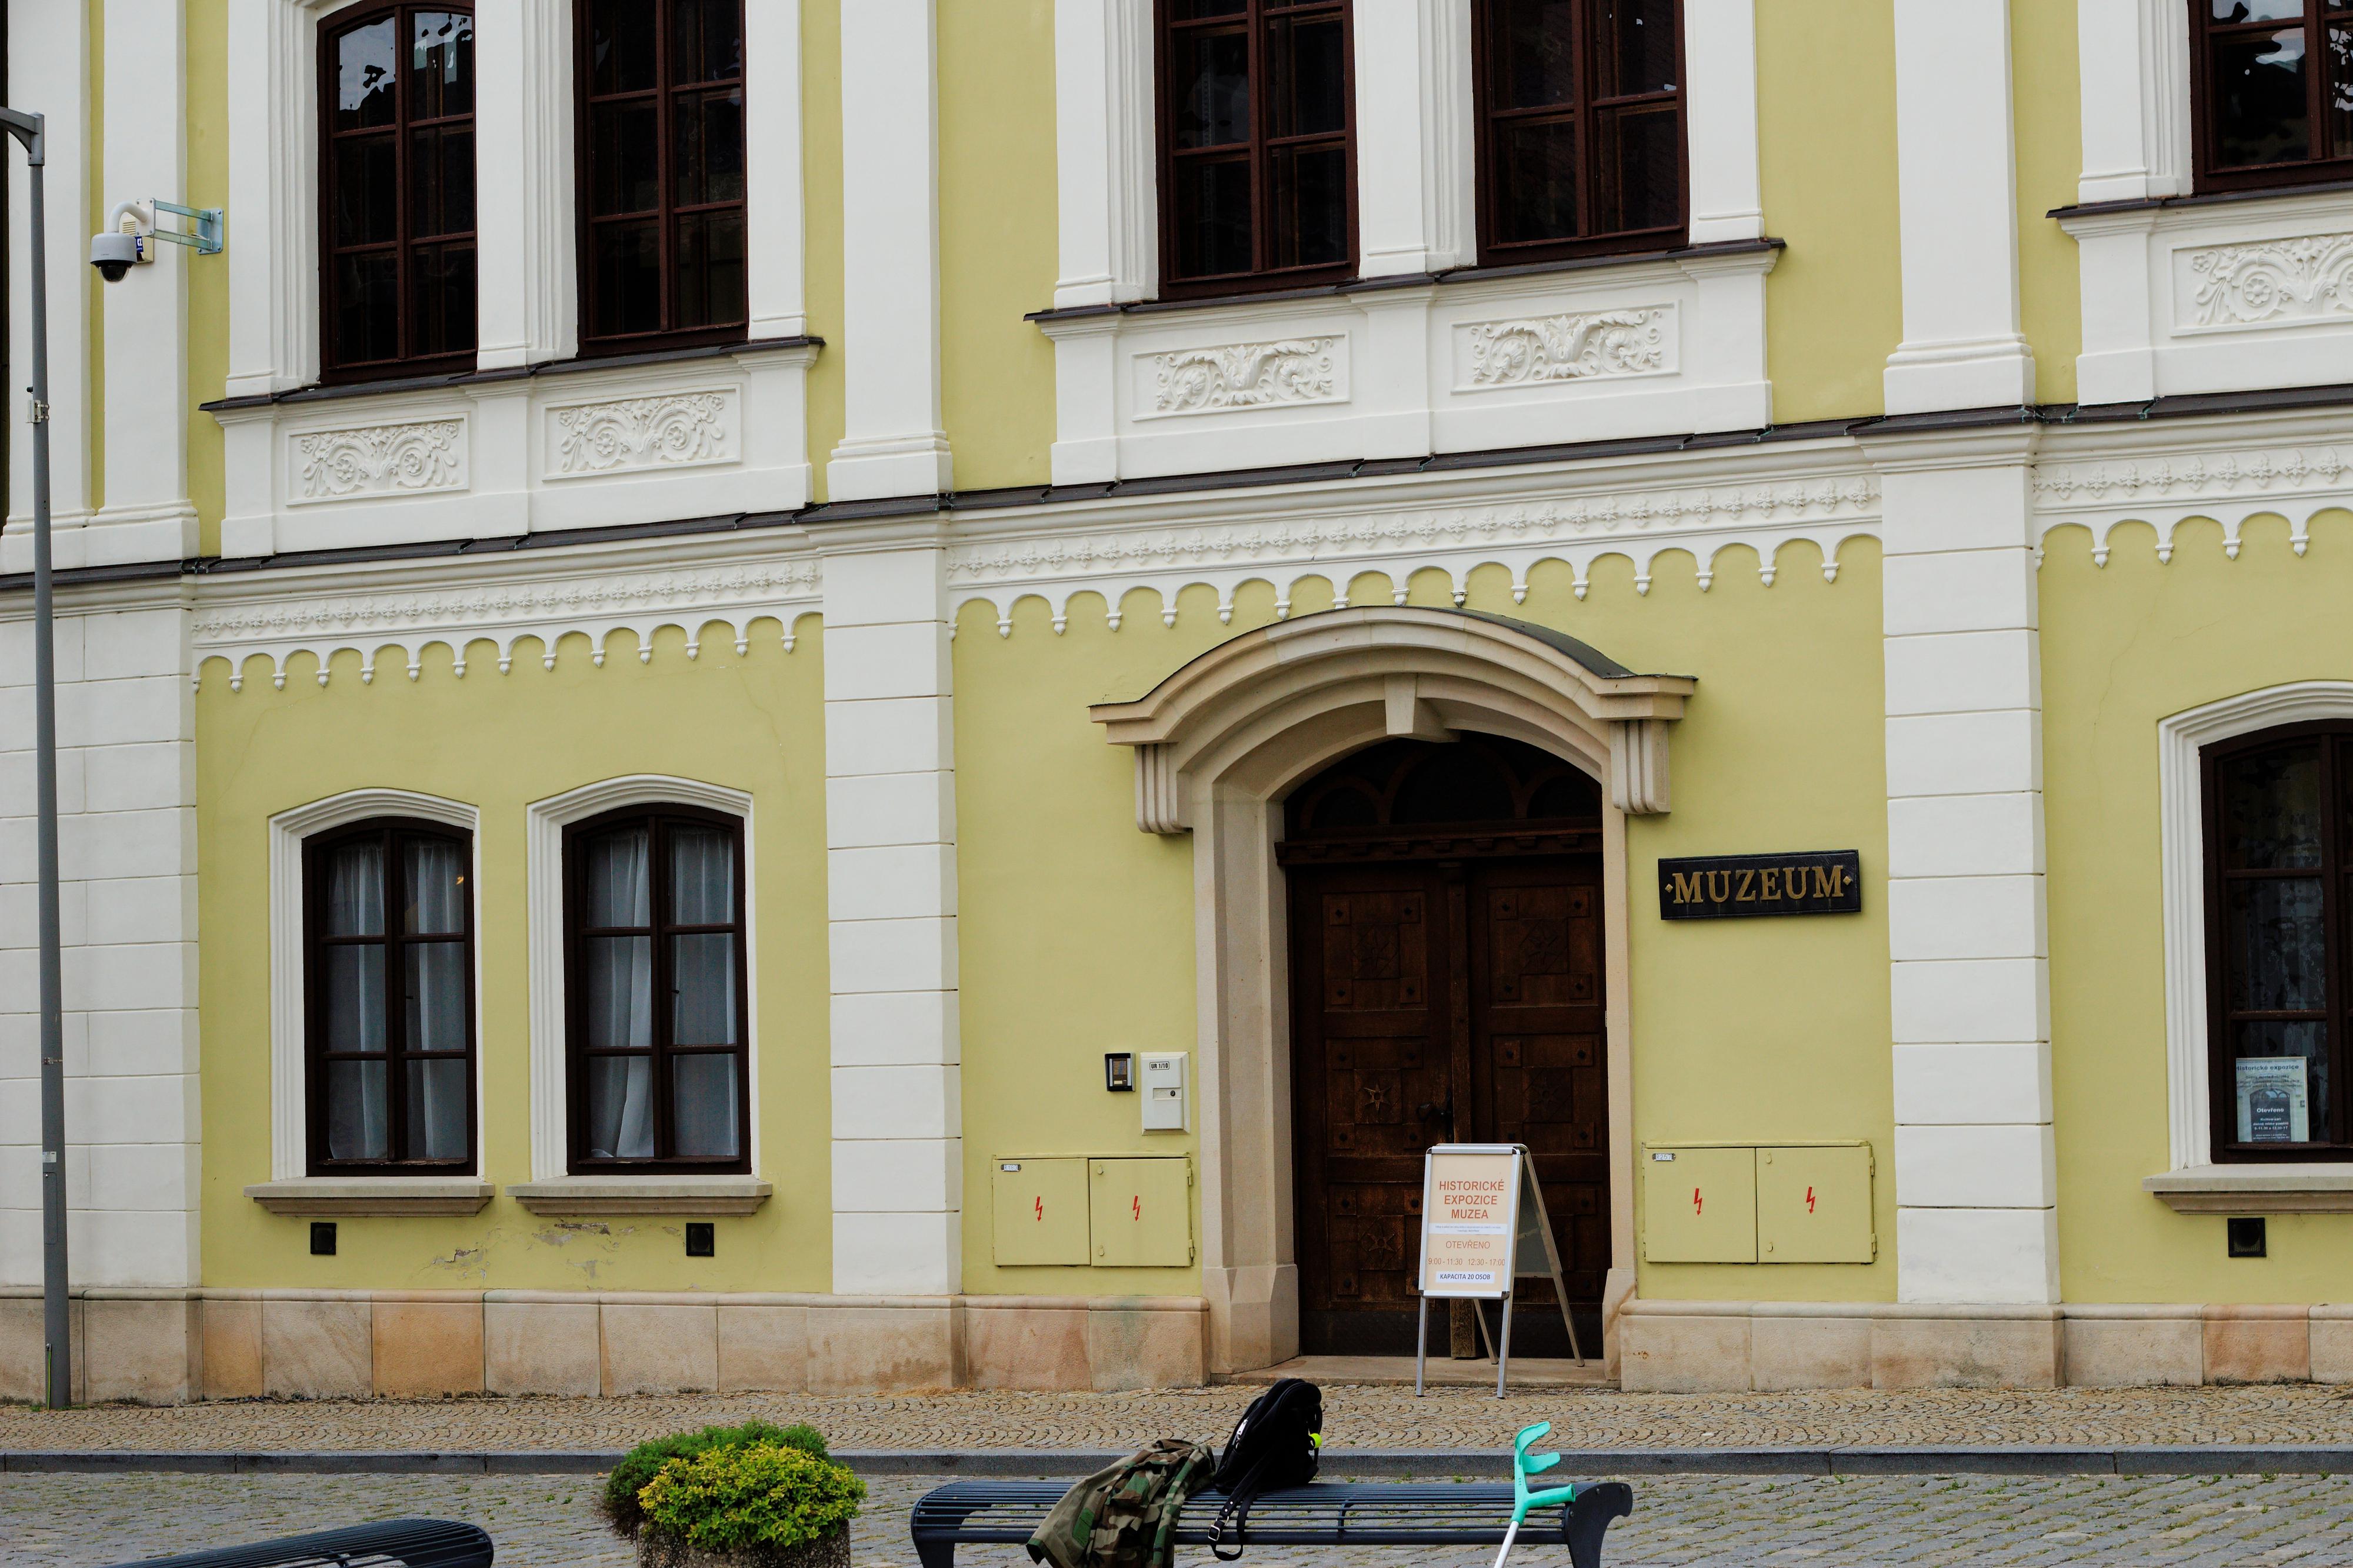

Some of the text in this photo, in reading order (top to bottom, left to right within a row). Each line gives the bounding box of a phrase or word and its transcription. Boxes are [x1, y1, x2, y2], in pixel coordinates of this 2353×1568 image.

[1672, 865, 1844, 904] MUZEUM
[1439, 1179, 1505, 1191] HISTORICKÉ
[1444, 1195, 1498, 1205] EXPOZICE
[1451, 1209, 1488, 1219] MUZEA
[1445, 1240, 1491, 1249] OTEVŘENO
